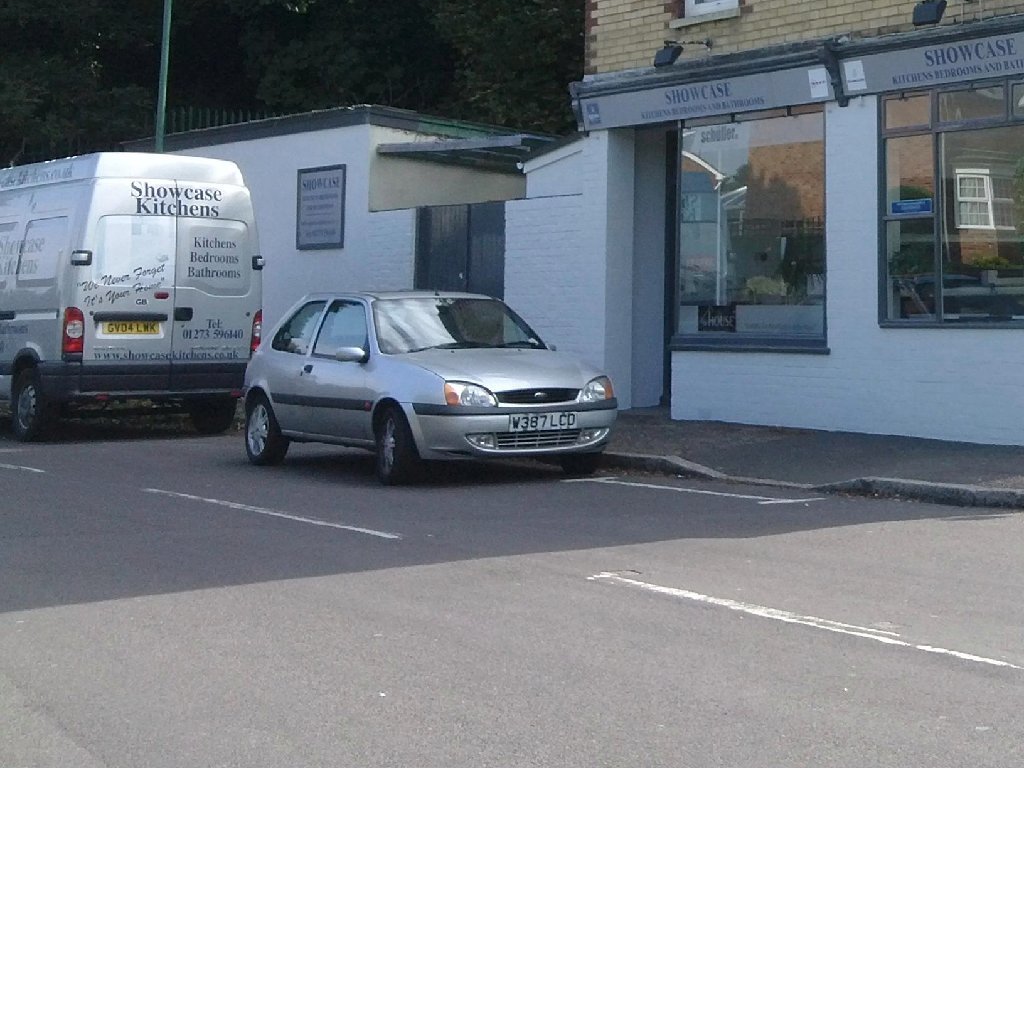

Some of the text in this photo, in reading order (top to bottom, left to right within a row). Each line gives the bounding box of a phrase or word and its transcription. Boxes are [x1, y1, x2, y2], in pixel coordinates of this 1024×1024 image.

[924, 37, 1017, 67] SHOWCASE
[892, 71, 934, 86] KITCHENS
[934, 64, 983, 80] BEDROOMS
[984, 61, 1003, 74] AND
[665, 82, 732, 105] SHOWCASE
[131, 180, 222, 202] Showcase
[136, 197, 220, 218] Kitchens
[193, 237, 237, 249] Kitchens
[190, 251, 240, 264] Bedrooms
[101, 274, 131, 286] Never
[134, 264, 165, 280] Forget
[188, 266, 241, 278] Bathrooms
[105, 290, 130, 304] Your
[135, 298, 148, 306] GB
[206, 319, 223, 329] Tel:
[182, 329, 244, 340] 01273 596140
[93, 349, 240, 361] www.showcasekitchens.co.uk
[512, 413, 576, 429] W387 LCD
